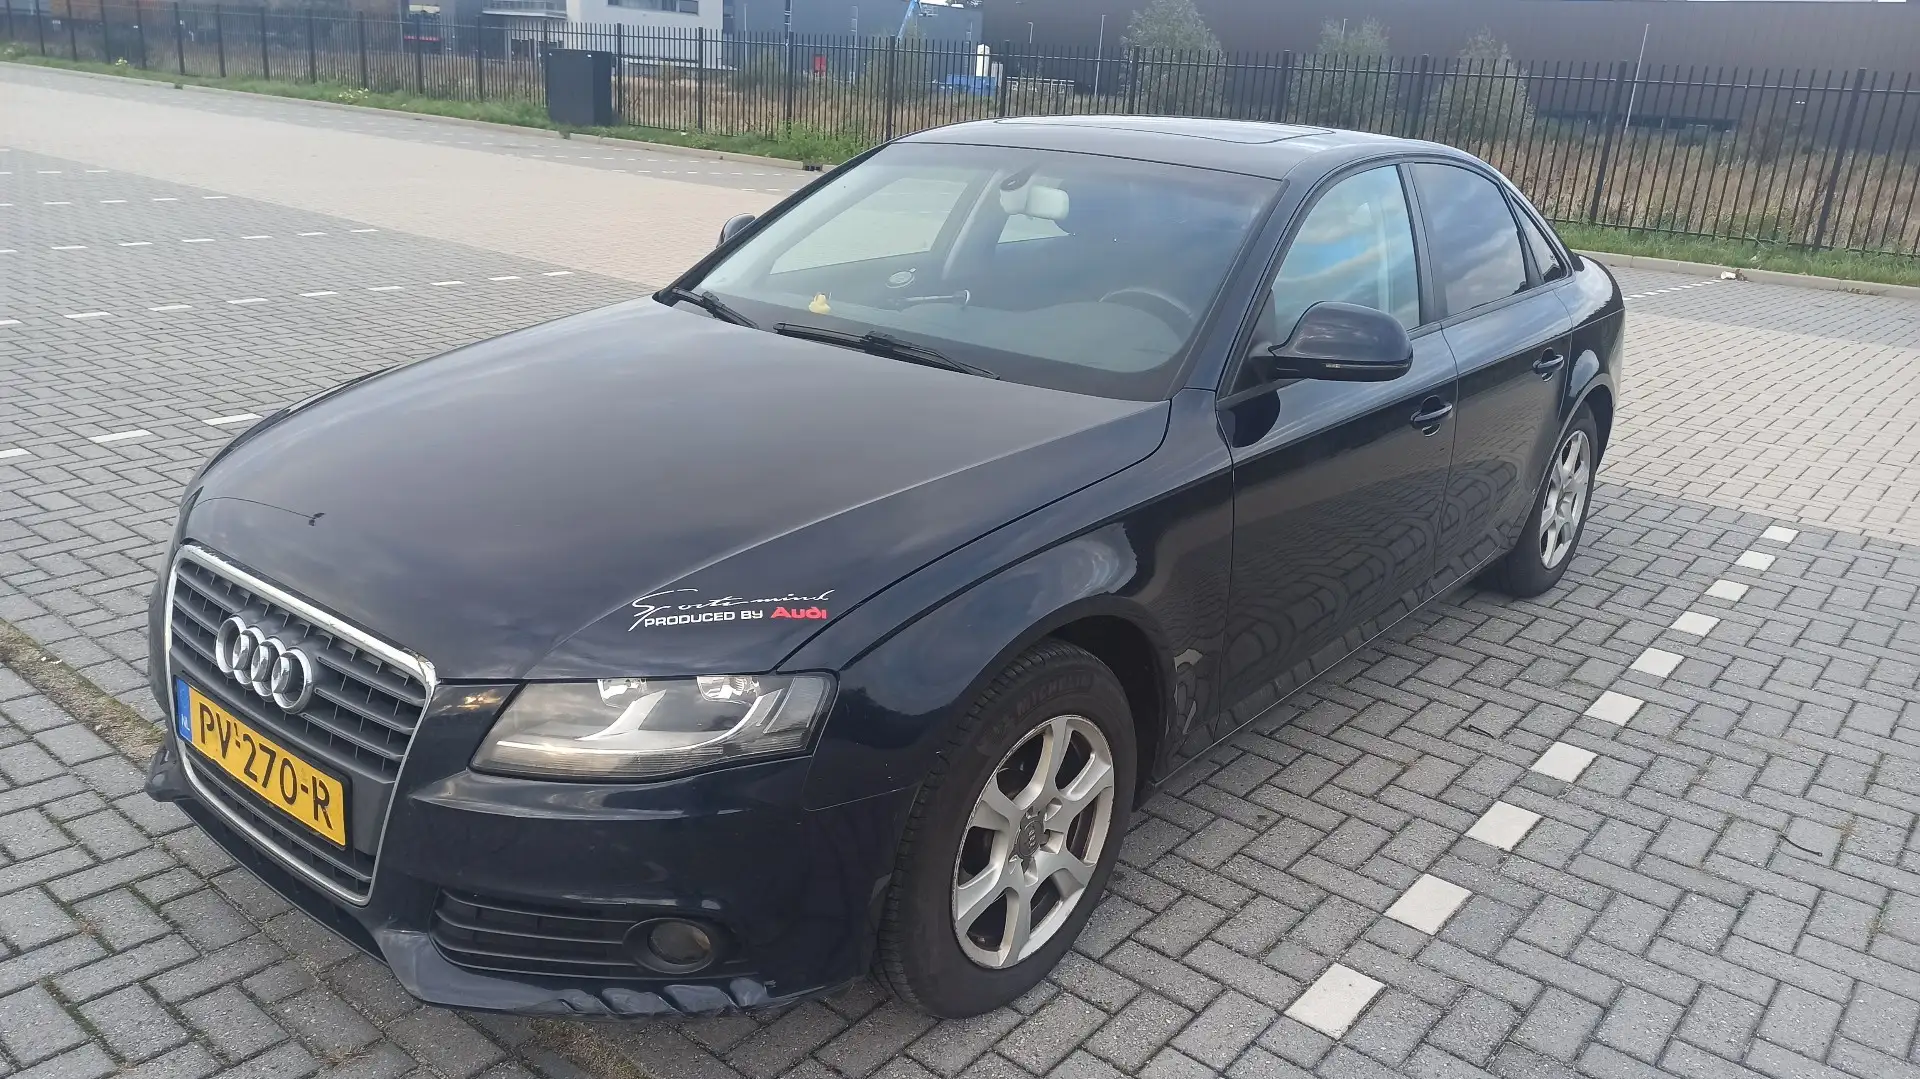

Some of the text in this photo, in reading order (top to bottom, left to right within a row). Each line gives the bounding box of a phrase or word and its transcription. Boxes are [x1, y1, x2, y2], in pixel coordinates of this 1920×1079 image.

[644, 606, 827, 628] PRODUCED BY Audi
[181, 713, 190, 731] NL
[199, 701, 333, 831] PV-270-R
